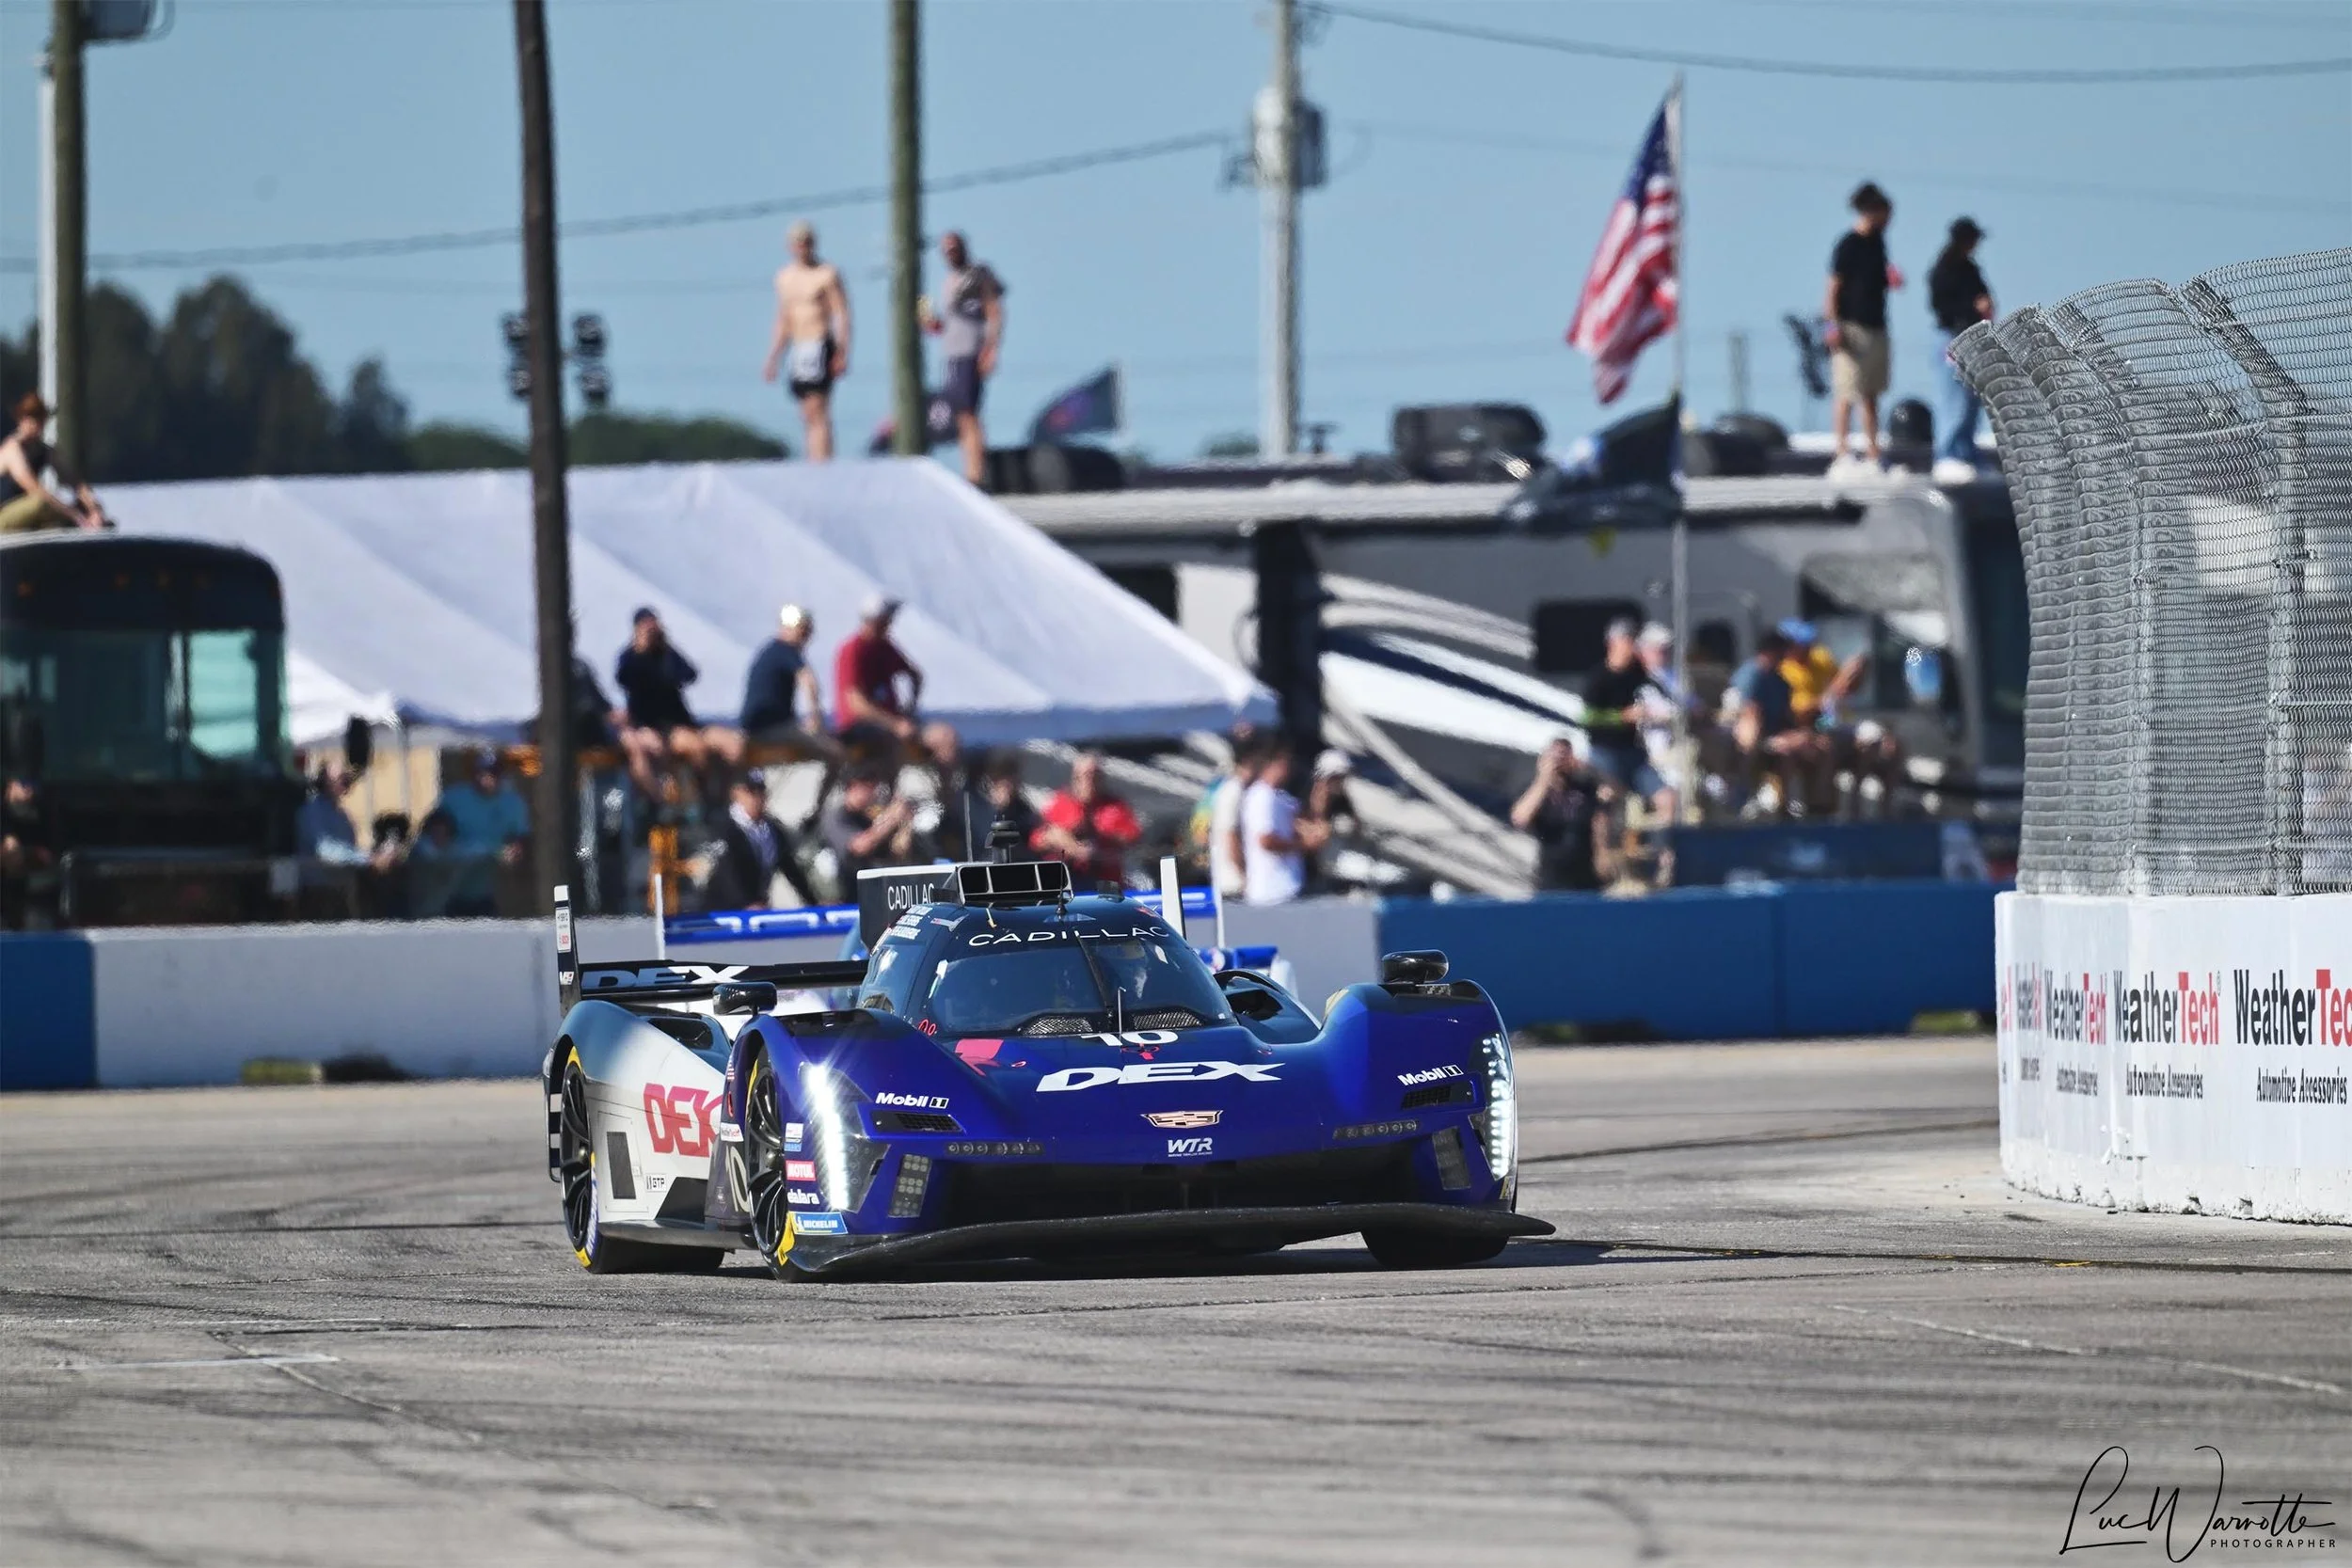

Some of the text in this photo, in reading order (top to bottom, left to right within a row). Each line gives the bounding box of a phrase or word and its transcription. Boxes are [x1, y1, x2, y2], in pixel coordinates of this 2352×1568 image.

[887, 883, 934, 911] CADILLAC
[968, 927, 1169, 947] CADILLAC
[580, 965, 750, 990] DEX
[2044, 970, 2106, 1045] WeatherTech
[2113, 970, 2219, 1045] WeatherTech
[1081, 1030, 1179, 1047] 10
[1035, 1061, 1286, 1092] DEX
[1397, 1068, 1445, 1086] Mobil
[2257, 1067, 2347, 1104] Automotive Accessories
[875, 1092, 930, 1108] Mobil
[1168, 1137, 1214, 1154] WTR
[652, 1177, 665, 1189] GTP
[725, 1144, 751, 1213] 10
